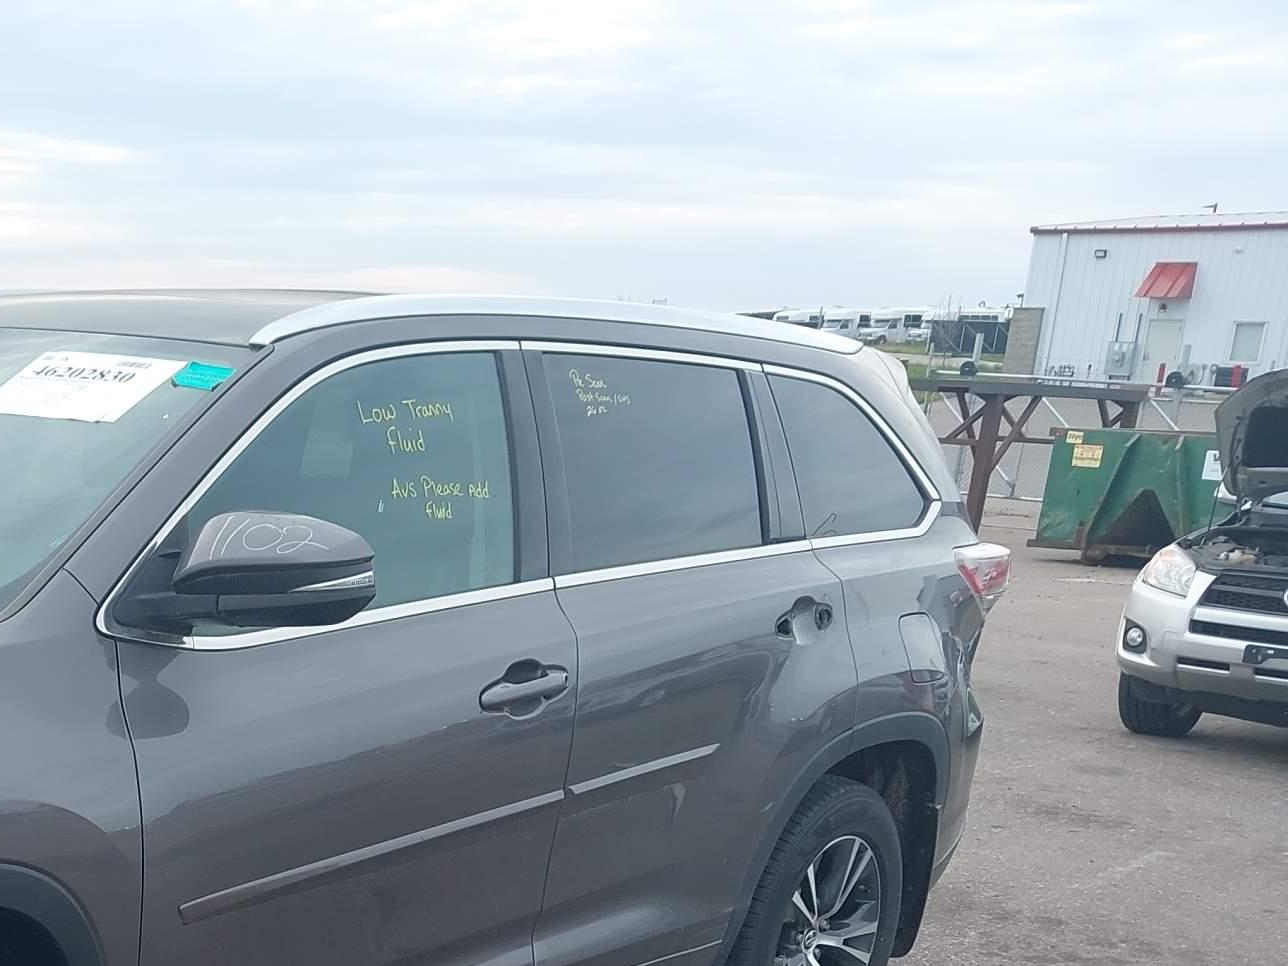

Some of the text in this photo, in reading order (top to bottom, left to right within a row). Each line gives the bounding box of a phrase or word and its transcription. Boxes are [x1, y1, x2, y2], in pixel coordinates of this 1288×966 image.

[32, 363, 137, 384] 46202830
[357, 399, 454, 425] Low Tranny
[420, 475, 464, 497] Please
